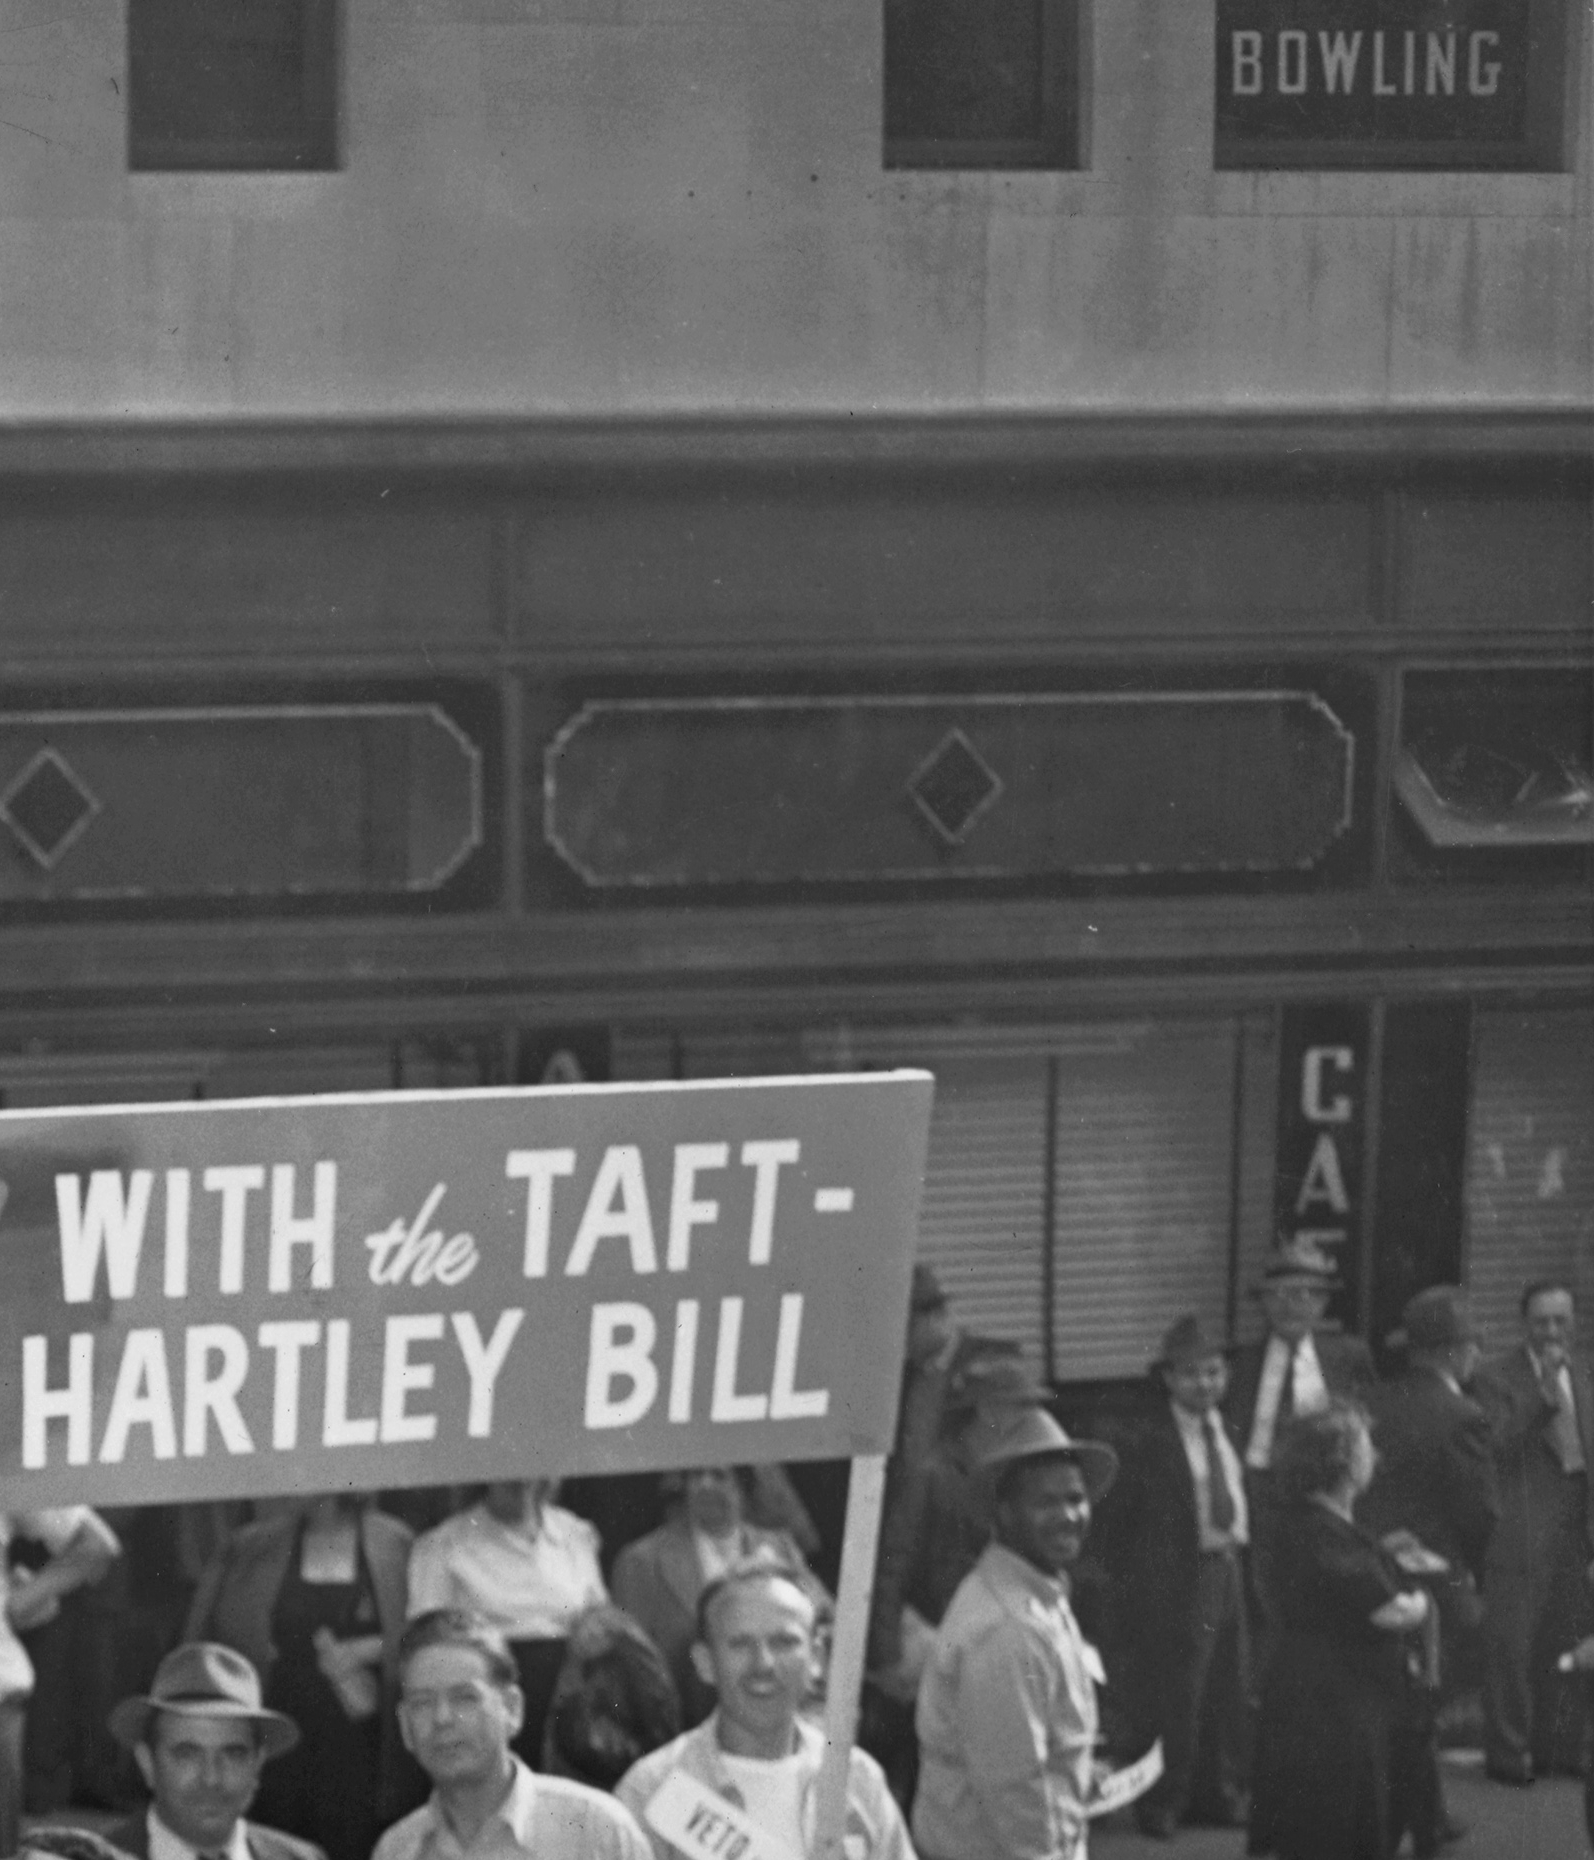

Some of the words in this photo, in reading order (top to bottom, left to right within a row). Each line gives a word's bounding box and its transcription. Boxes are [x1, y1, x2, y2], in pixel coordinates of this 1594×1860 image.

[1231, 29, 1503, 96] BOWLING
[54, 1160, 338, 1303] WITH
[363, 1182, 480, 1287] the
[505, 1138, 855, 1278] TAFT-
[20, 1307, 525, 1470] HARTLEY
[583, 1293, 830, 1430] BILL
